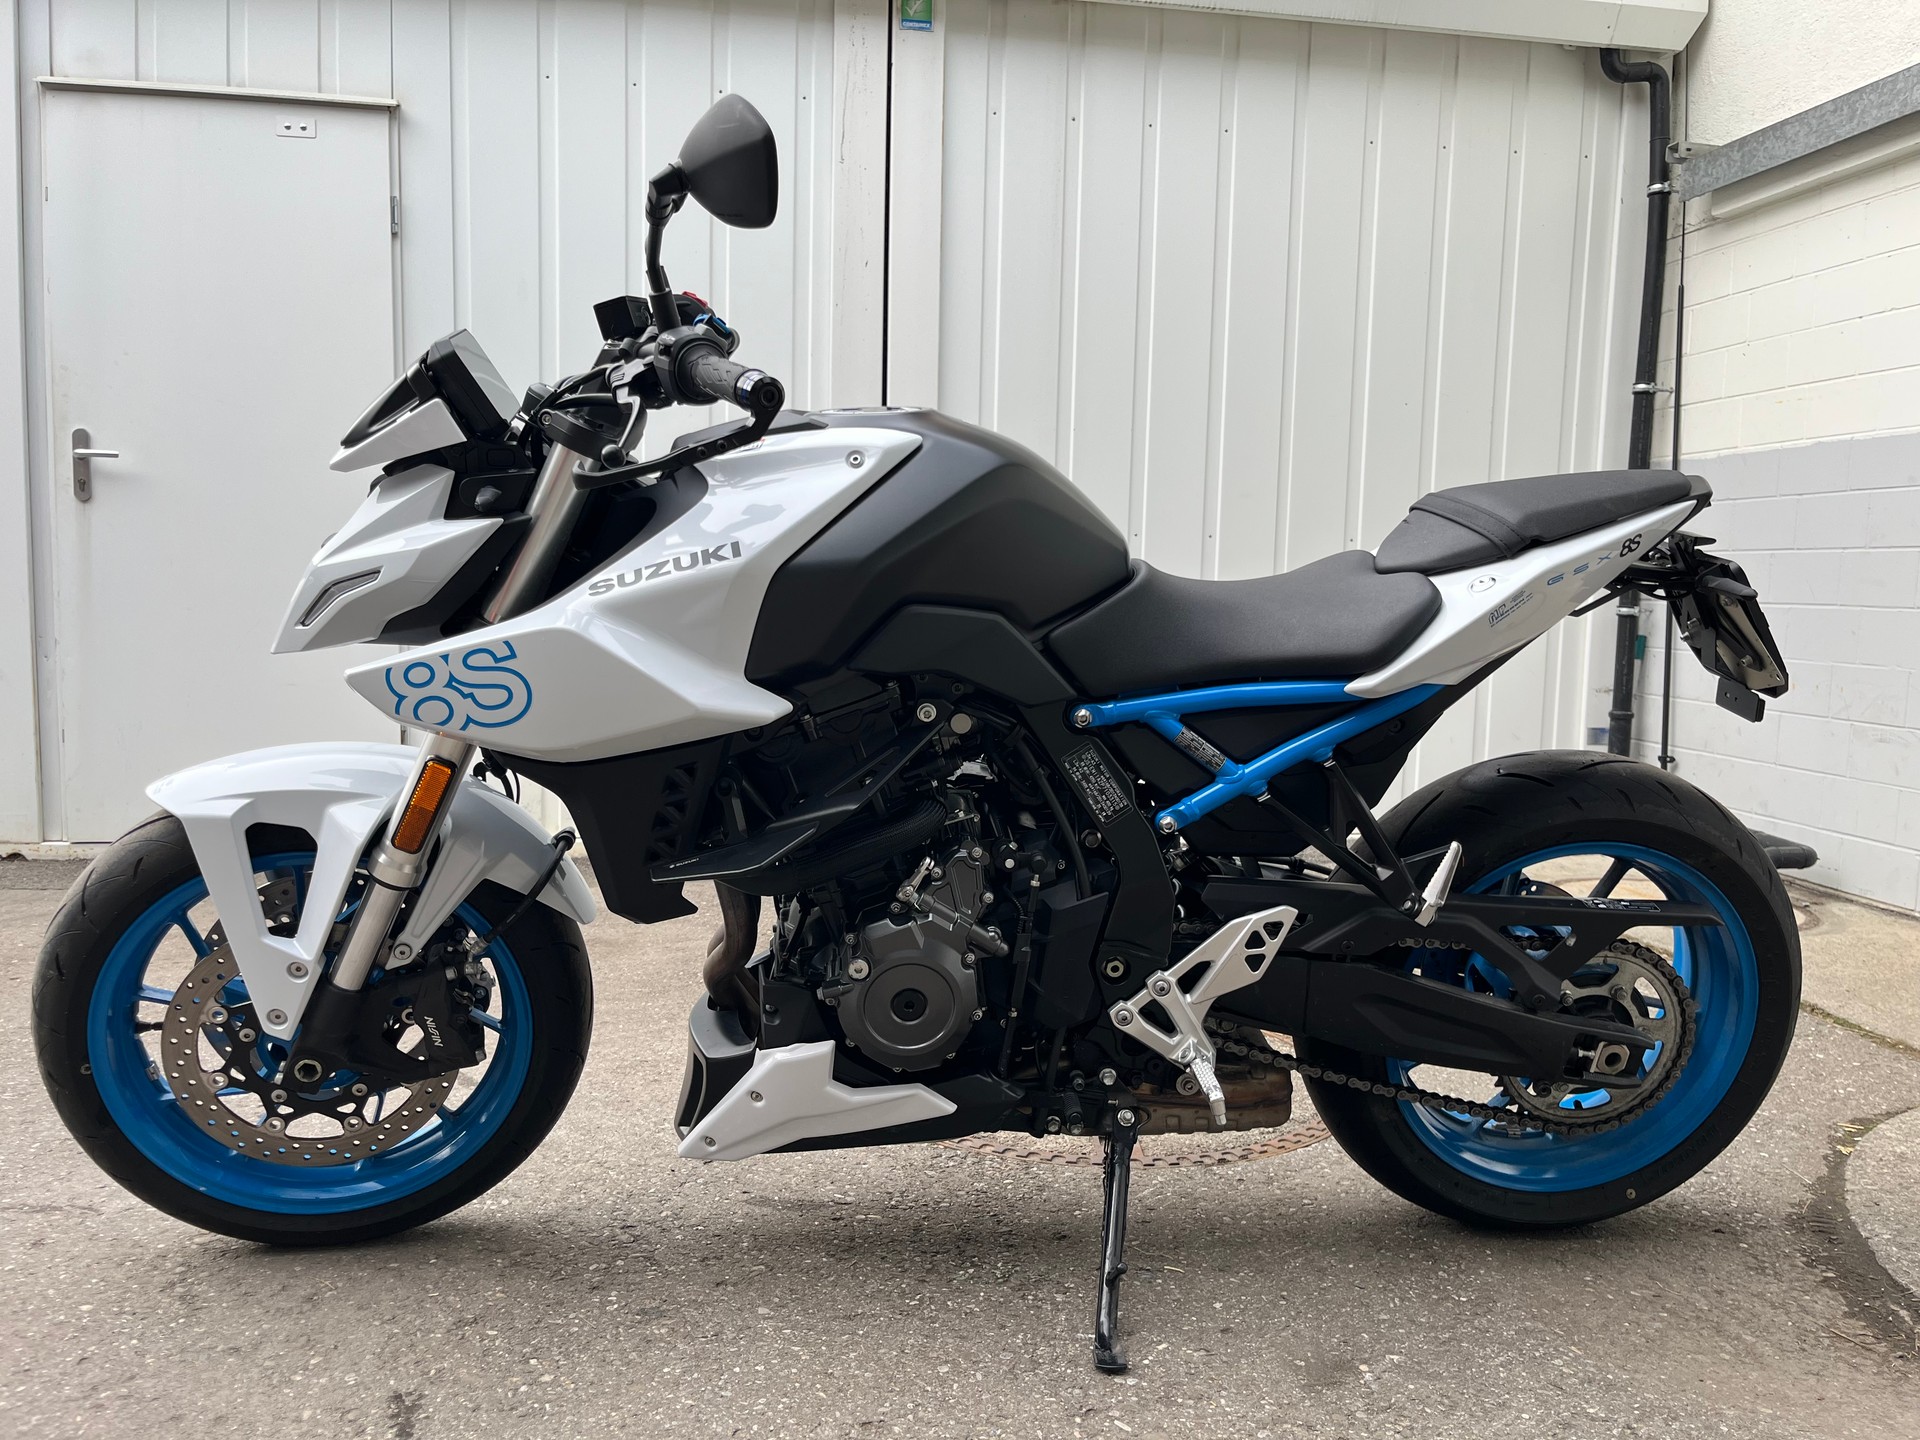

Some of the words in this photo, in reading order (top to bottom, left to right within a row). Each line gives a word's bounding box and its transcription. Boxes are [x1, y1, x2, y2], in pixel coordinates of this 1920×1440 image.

[1619, 533, 1643, 558] 8S
[588, 540, 742, 597] SUZUKI
[385, 640, 533, 731] 8S
[423, 1016, 444, 1047] NISSIN
